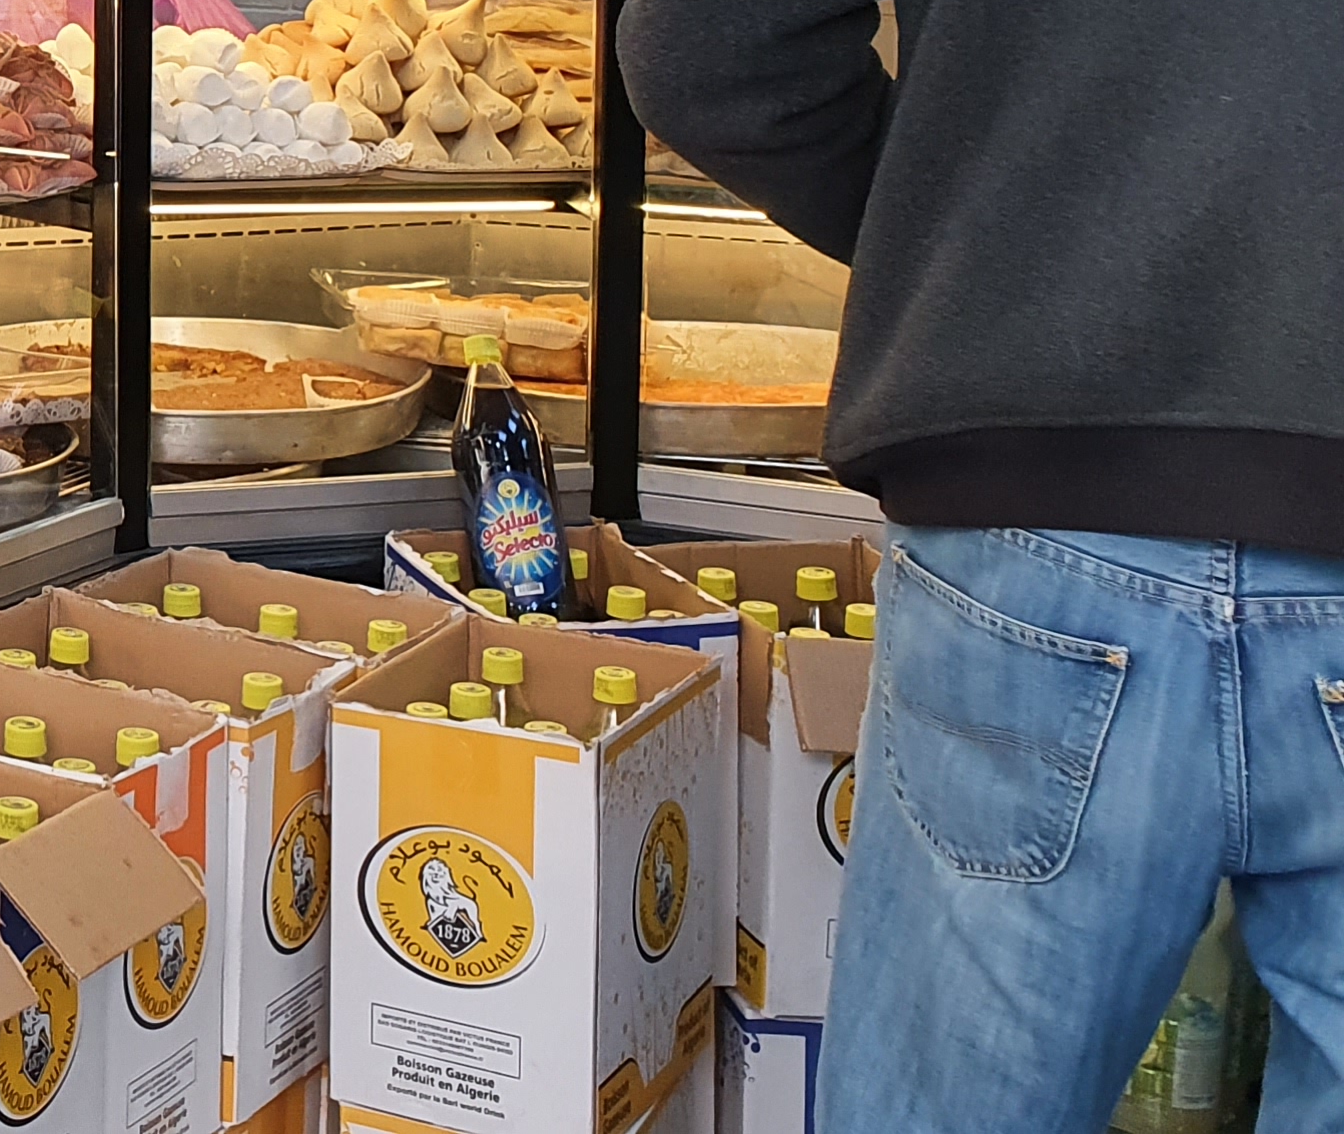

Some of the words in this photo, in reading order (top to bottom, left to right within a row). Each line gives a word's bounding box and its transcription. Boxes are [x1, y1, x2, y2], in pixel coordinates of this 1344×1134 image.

[494, 532, 554, 564] Selecto
[389, 839, 451, 886] بوعلام
[458, 842, 515, 899] حمود
[380, 901, 450, 973] HAMOUD
[455, 924, 529, 978] BOUALEM
[437, 924, 471, 944] 1878
[392, 1066, 435, 1088] Produit
[438, 1080, 454, 1092] en
[456, 1082, 501, 1104] Algerie
[397, 1054, 443, 1076] Boisson
[445, 1067, 496, 1089] Gazeuse
